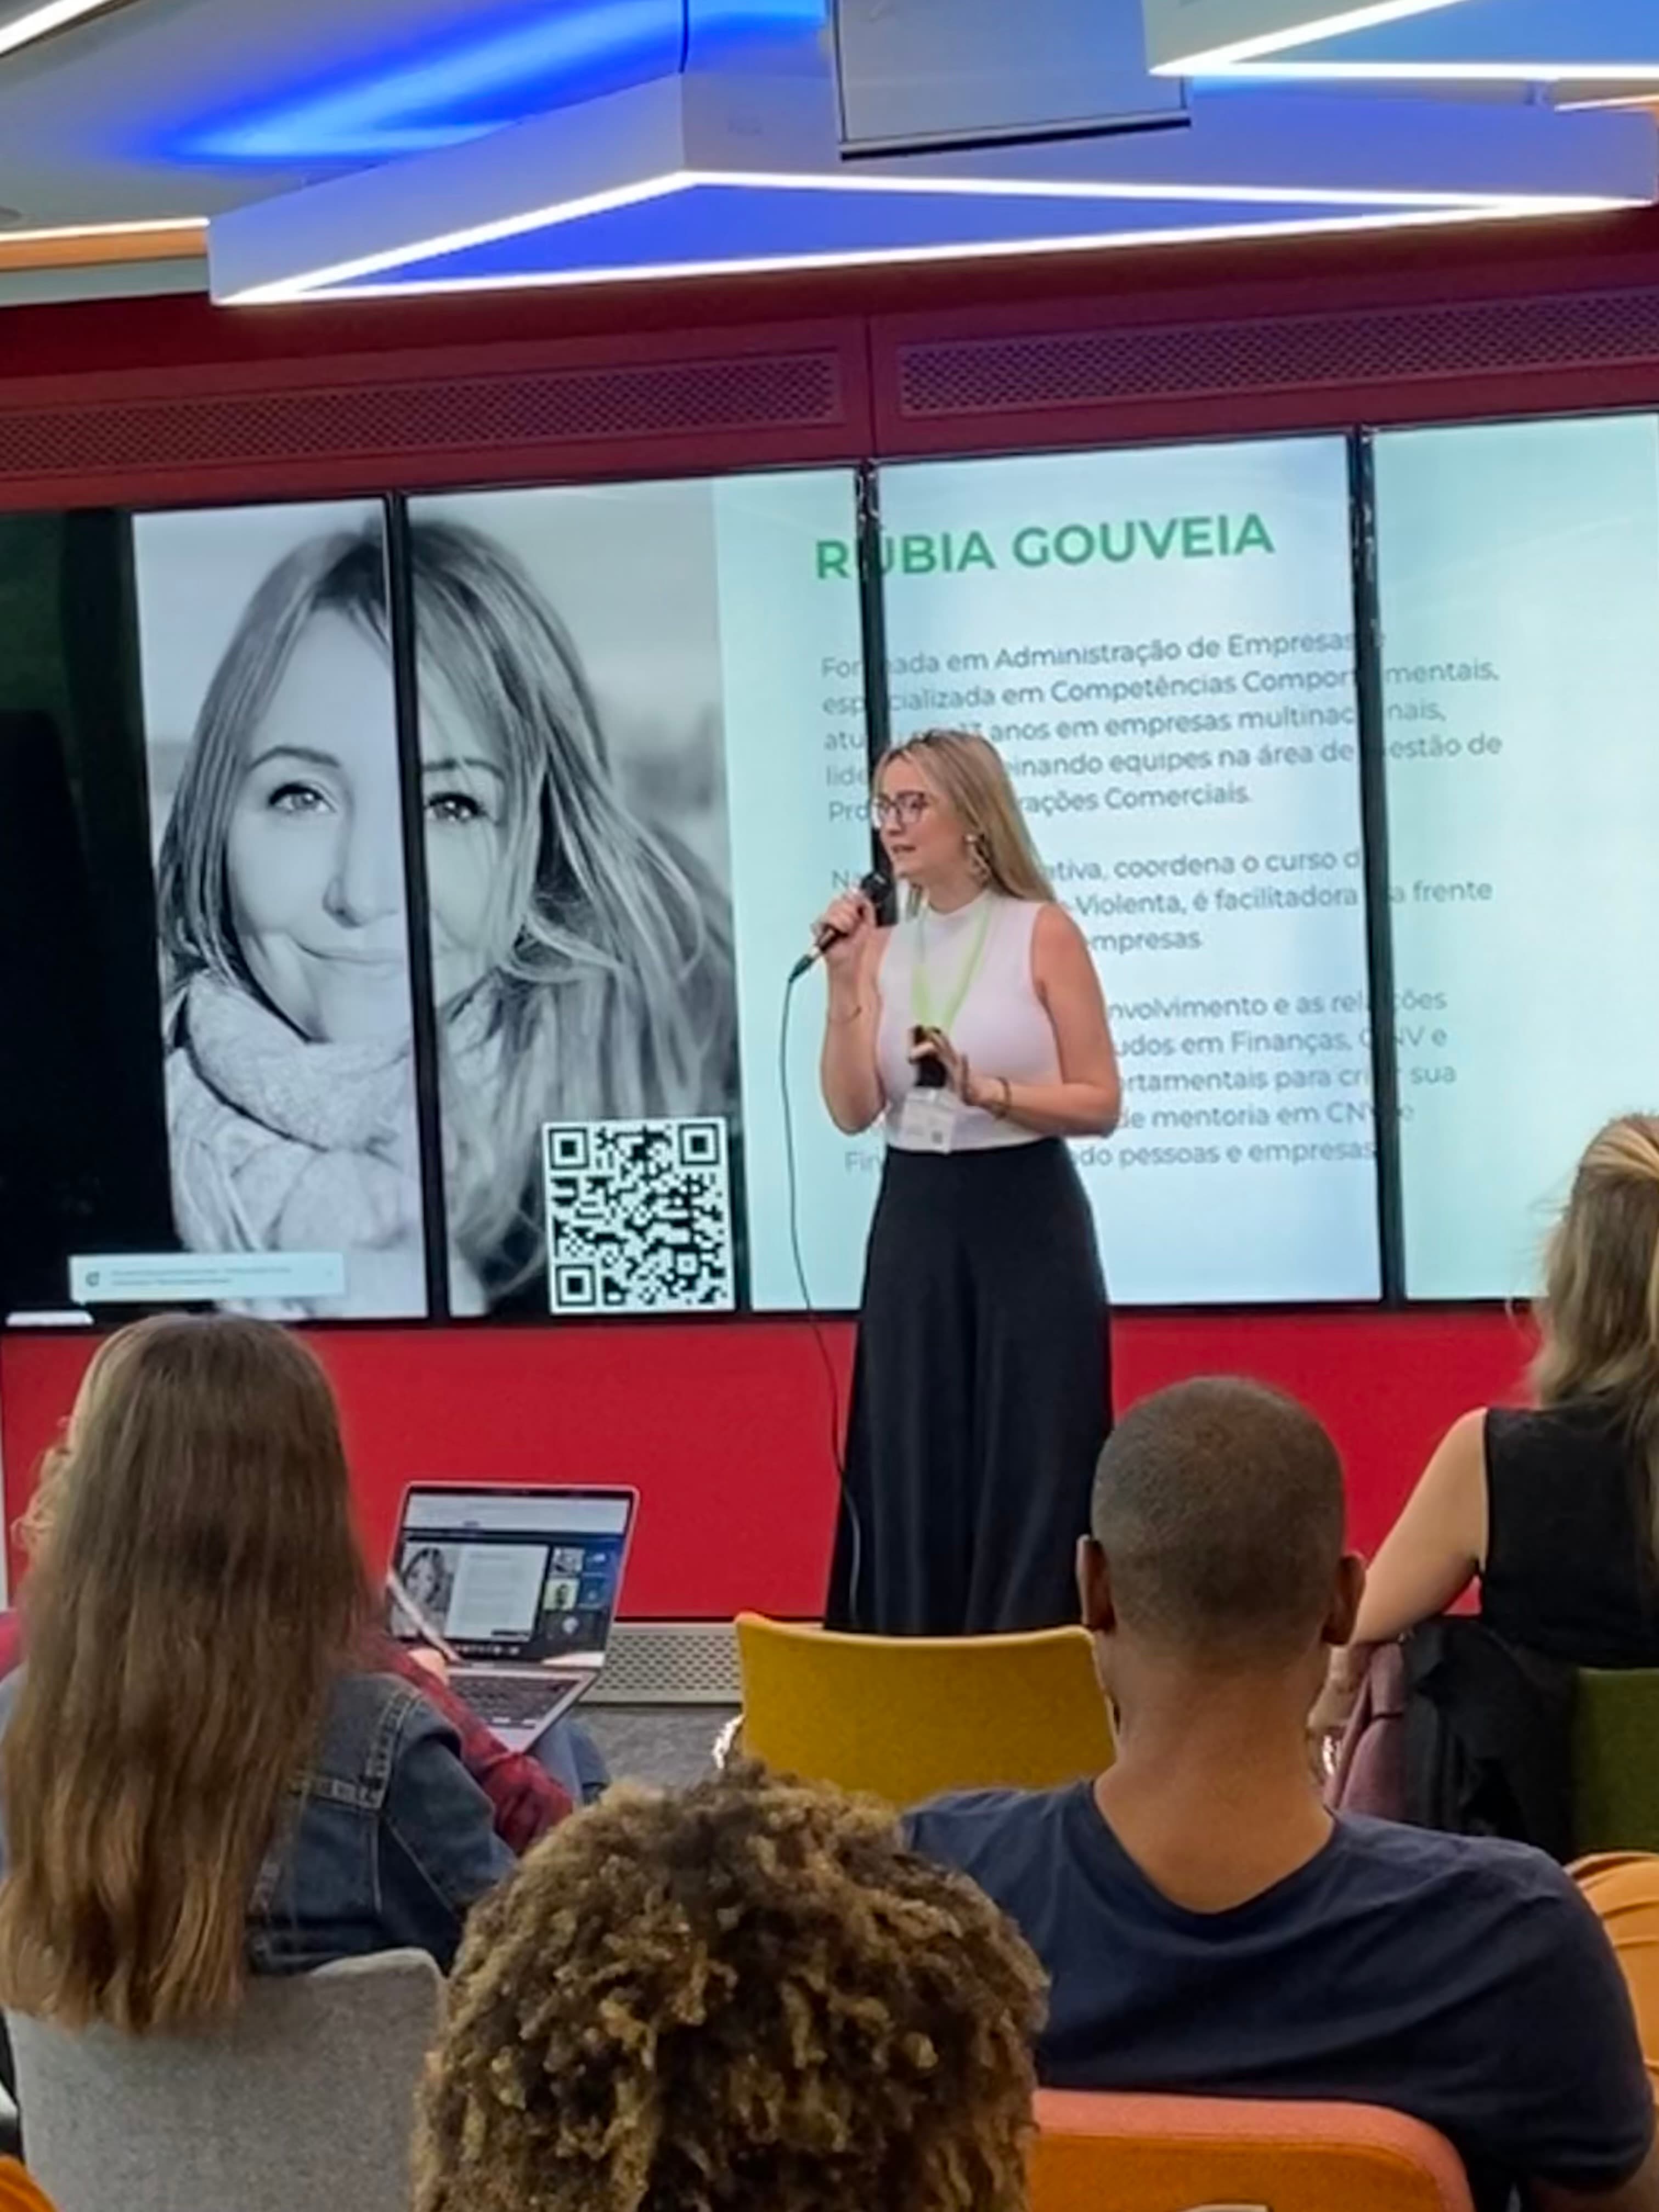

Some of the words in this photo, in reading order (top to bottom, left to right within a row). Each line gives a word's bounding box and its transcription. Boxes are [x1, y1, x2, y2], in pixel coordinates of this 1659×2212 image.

[1013, 512, 1275, 568] GOUVEIA
[822, 651, 939, 678] Forada
[947, 653, 988, 672] em
[996, 639, 1181, 670] Administração
[1188, 635, 1219, 659] de
[823, 686, 995, 716] espcializada
[1002, 686, 1042, 706] em
[1051, 673, 1237, 707] Competências
[1243, 659, 1500, 699] Compormentais,
[991, 720, 1051, 743] anos
[1056, 718, 1097, 738] em
[1105, 712, 1231, 742] empresas
[1239, 698, 1447, 730] multinacnais,
[1109, 748, 1212, 775] equipes
[1218, 747, 1250, 767] na
[1257, 738, 1313, 765] área
[1320, 737, 1355, 763] de
[1390, 733, 1462, 759] estão
[1468, 732, 1503, 755] de
[1113, 853, 1235, 879] coordena
[1242, 854, 1260, 873] o
[1265, 851, 1338, 872] curso
[1075, 893, 1187, 917] Violenta,
[1193, 890, 1207, 912] é
[1216, 884, 1358, 911] facilitadora
[1412, 879, 1493, 904] frente
[1088, 930, 1201, 955] mpresas
[1109, 996, 1268, 1020] nvolvimento
[1274, 997, 1289, 1014] e
[1295, 996, 1324, 1014] as
[1332, 989, 1448, 1013] relões
[1182, 1035, 1223, 1054] em
[1232, 1029, 1353, 1054] Finanças,
[1431, 1028, 1447, 1047] e
[1126, 1066, 1268, 1092] rtamentais
[1276, 1069, 1331, 1092] para
[1410, 1066, 1456, 1085] sua
[1152, 1104, 1269, 1128] mentoria
[1277, 1106, 1320, 1125] em
[1119, 1145, 1221, 1170] pessoas
[1226, 1144, 1242, 1164] e
